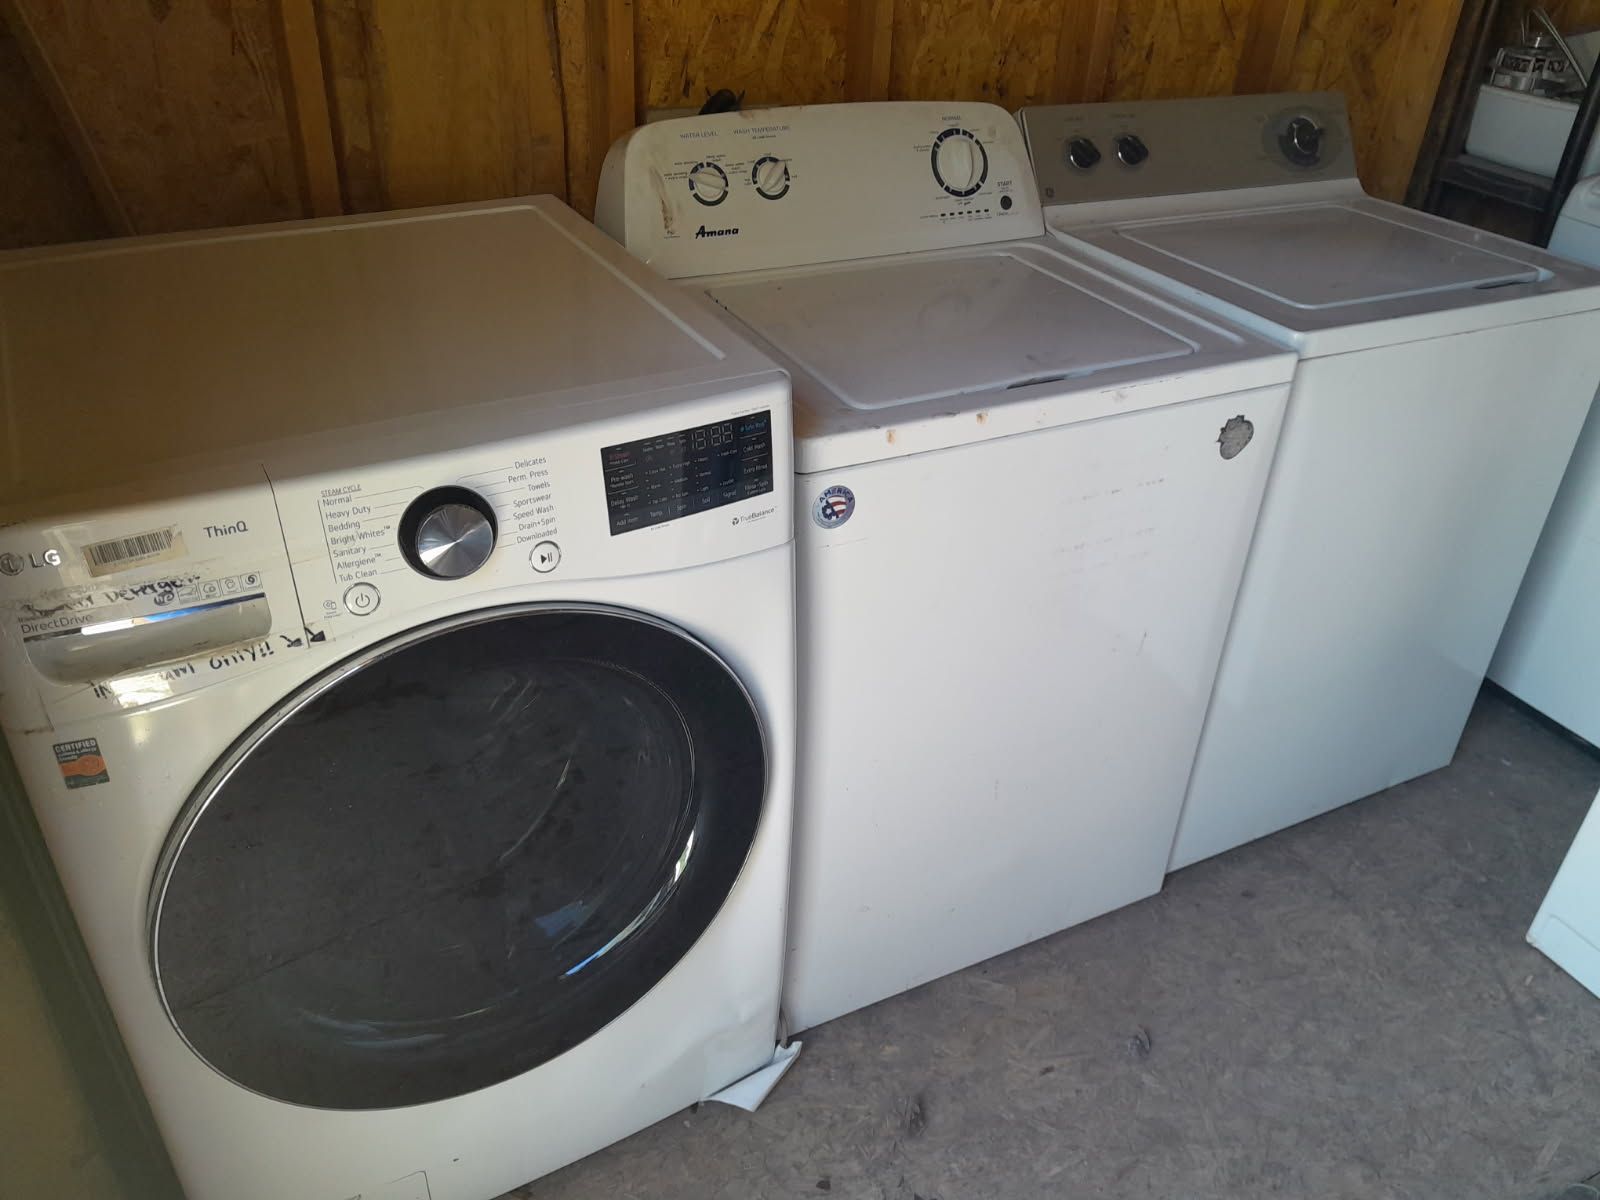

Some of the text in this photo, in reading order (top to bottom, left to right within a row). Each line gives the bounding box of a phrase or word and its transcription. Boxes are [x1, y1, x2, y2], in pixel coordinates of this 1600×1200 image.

[695, 225, 739, 239] Amana
[514, 457, 547, 470] Delicates
[507, 469, 549, 484] Perm. Press
[320, 484, 362, 498] STEAM CYCLE
[527, 481, 551, 492] Towels
[322, 494, 353, 508] Normal
[513, 493, 551, 508] Sportswear
[819, 487, 853, 504] AMERICA
[325, 504, 372, 521] Heavy Duty
[512, 504, 555, 521] Speed Wash
[203, 520, 249, 540] ThinQ
[327, 519, 361, 534] Bedding
[518, 516, 557, 532] Drain+Spin
[330, 533, 356, 548] Bright
[516, 528, 558, 545] Downloaded
[333, 544, 367, 558] Sanitary
[29, 549, 61, 569] LG
[338, 568, 378, 583] Tub Clean
[54, 739, 97, 754] CERTIFIED
